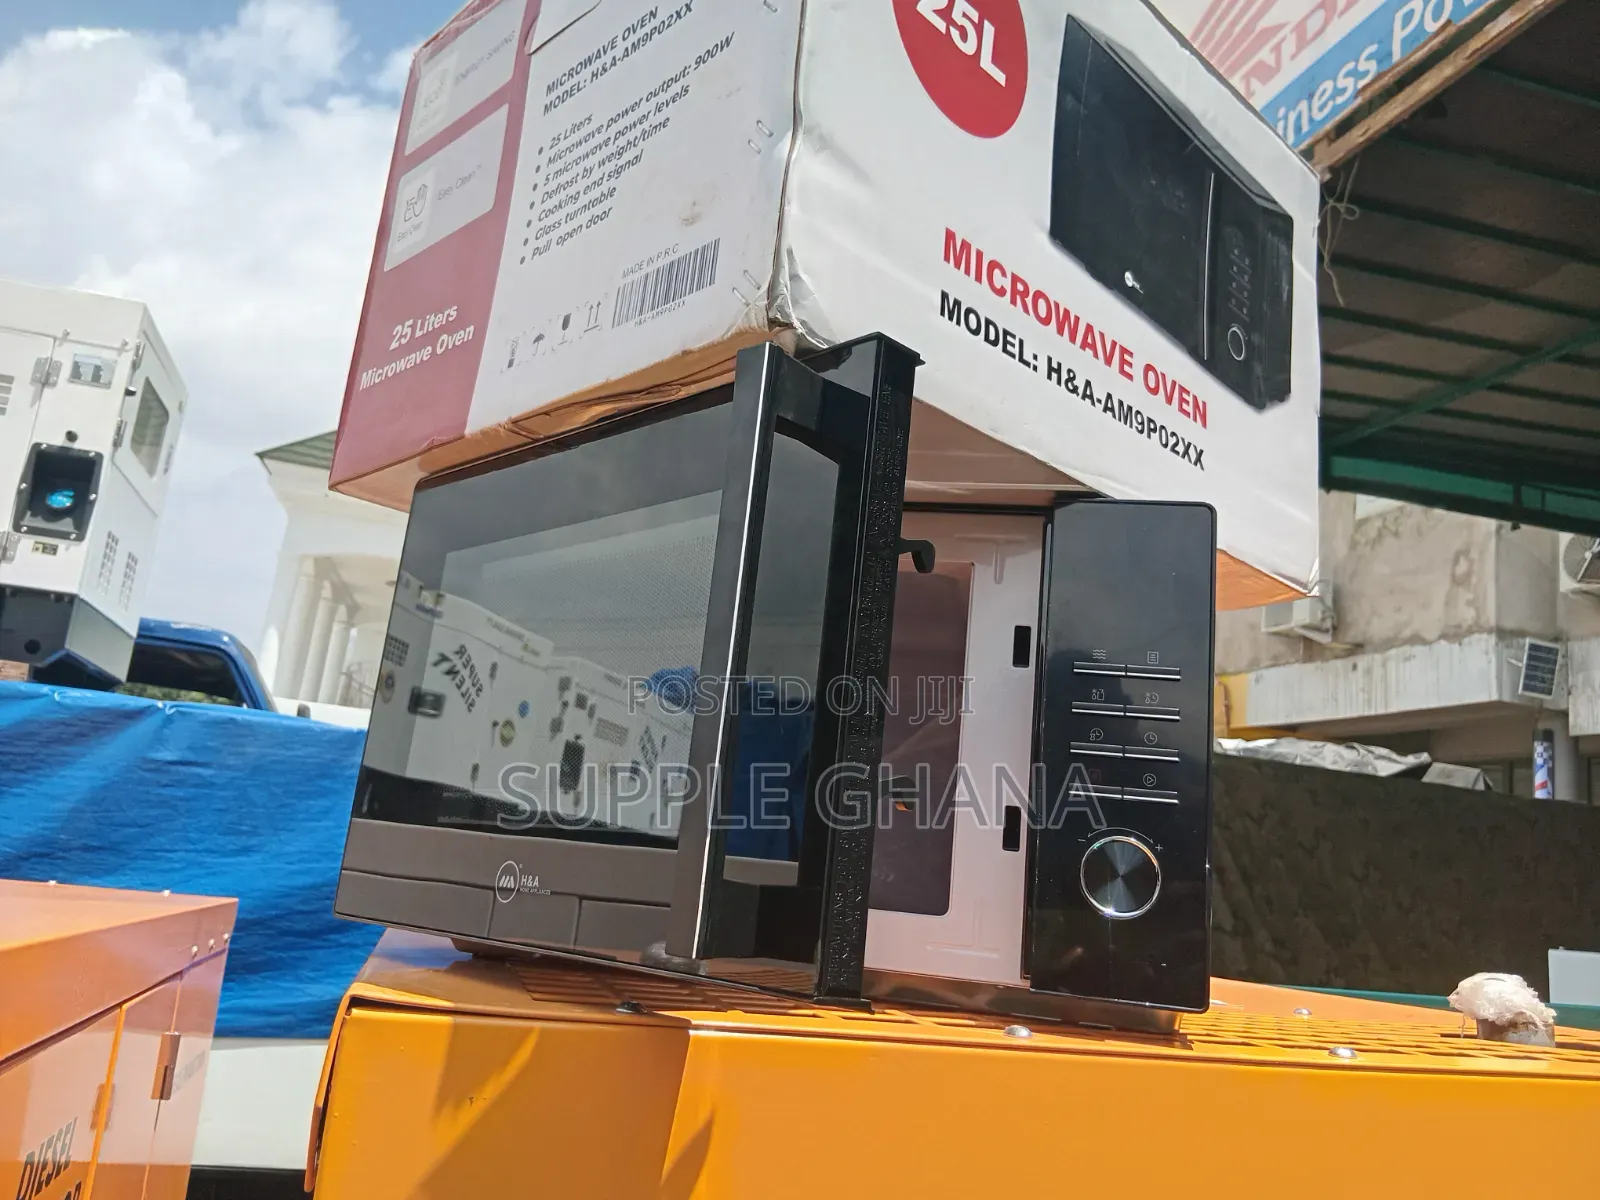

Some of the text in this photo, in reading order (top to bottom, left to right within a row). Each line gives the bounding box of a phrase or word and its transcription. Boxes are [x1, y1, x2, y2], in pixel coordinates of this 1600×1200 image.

[543, 0, 694, 116] MODEL: H&A-AM9P02XX
[545, 6, 659, 98] MICROWAVE OVEN
[916, 0, 1006, 88] 25L
[1392, 0, 1480, 62] Po
[543, 83, 690, 187] 5 microwave power levels
[546, 31, 736, 169] Microwave power output: 900W
[549, 112, 593, 150] 25 Liters
[538, 149, 645, 225] Cooking end signal
[540, 115, 671, 206] Defrost by weight/time
[531, 206, 613, 261] Pull open door
[535, 186, 617, 241] Glass turntable
[621, 260, 645, 279] MADE
[646, 256, 656, 267] IN
[359, 323, 475, 391] Microwave Oven
[389, 304, 458, 351] 25 Liters
[943, 227, 1209, 430] MICROWAVE OVEN
[939, 289, 1206, 471] MODEL: H&A-AM9P02XX
[520, 874, 539, 887] H&A
